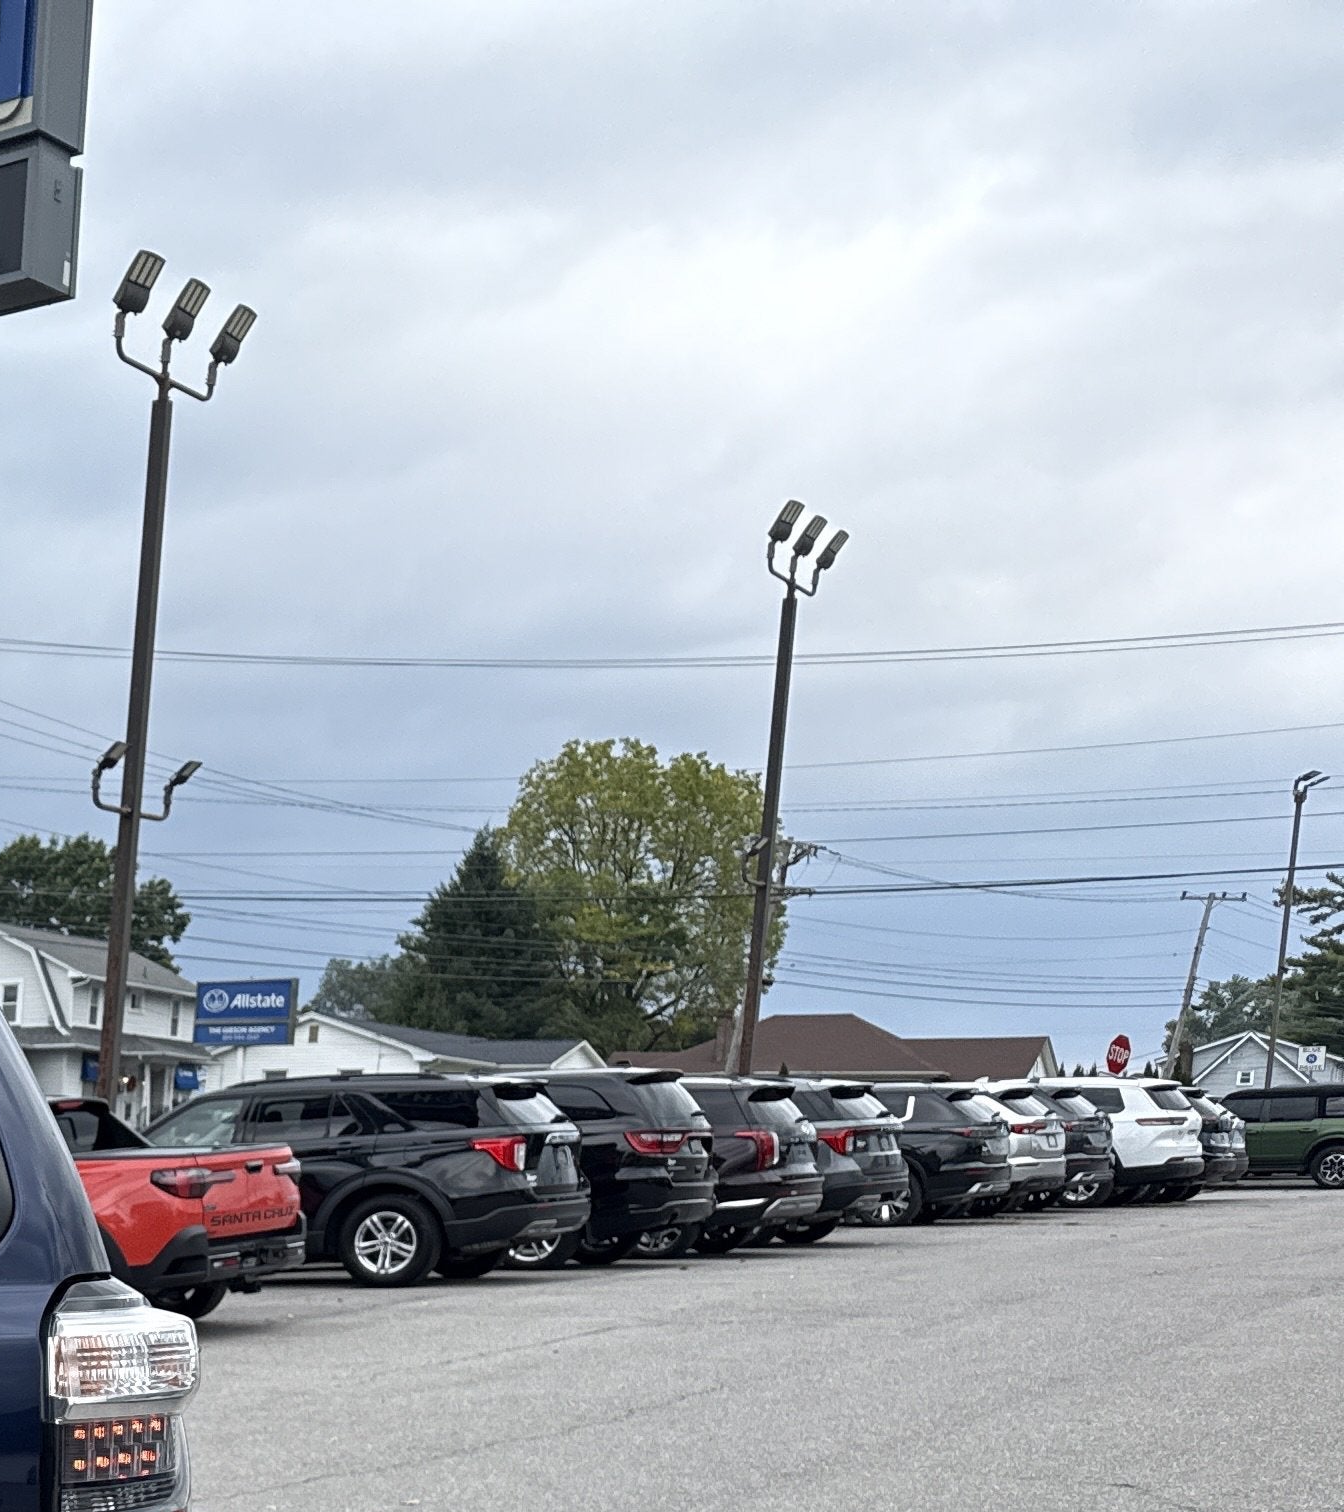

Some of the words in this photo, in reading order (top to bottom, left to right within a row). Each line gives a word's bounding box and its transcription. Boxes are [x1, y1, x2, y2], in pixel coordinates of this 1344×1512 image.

[230, 993, 285, 1009] Allstate
[1109, 1045, 1129, 1064] STOP
[210, 1210, 261, 1227] SANTA
[264, 1205, 295, 1219] CRUZ
